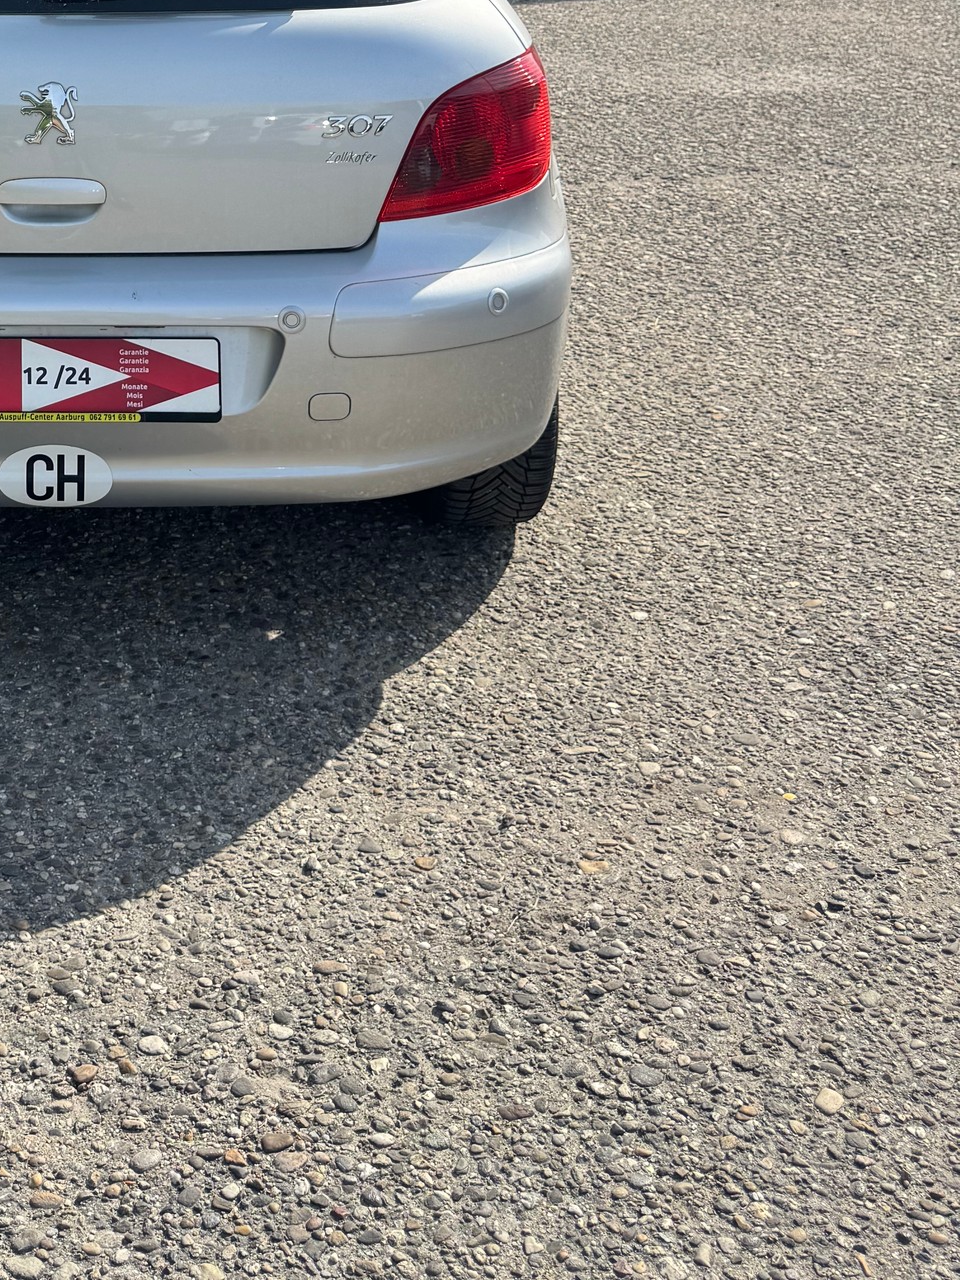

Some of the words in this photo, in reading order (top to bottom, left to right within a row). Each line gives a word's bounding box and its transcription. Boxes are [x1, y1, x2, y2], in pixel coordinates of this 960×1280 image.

[321, 113, 394, 139] 307
[325, 151, 378, 165] Zollikofer
[119, 357, 149, 365] Garantie
[23, 367, 48, 385] 12
[0, 413, 54, 422] Auspuff-Center
[56, 413, 85, 422] Aarburg
[89, 413, 102, 421] 062
[103, 413, 116, 421] 791
[25, 454, 85, 502] CH
